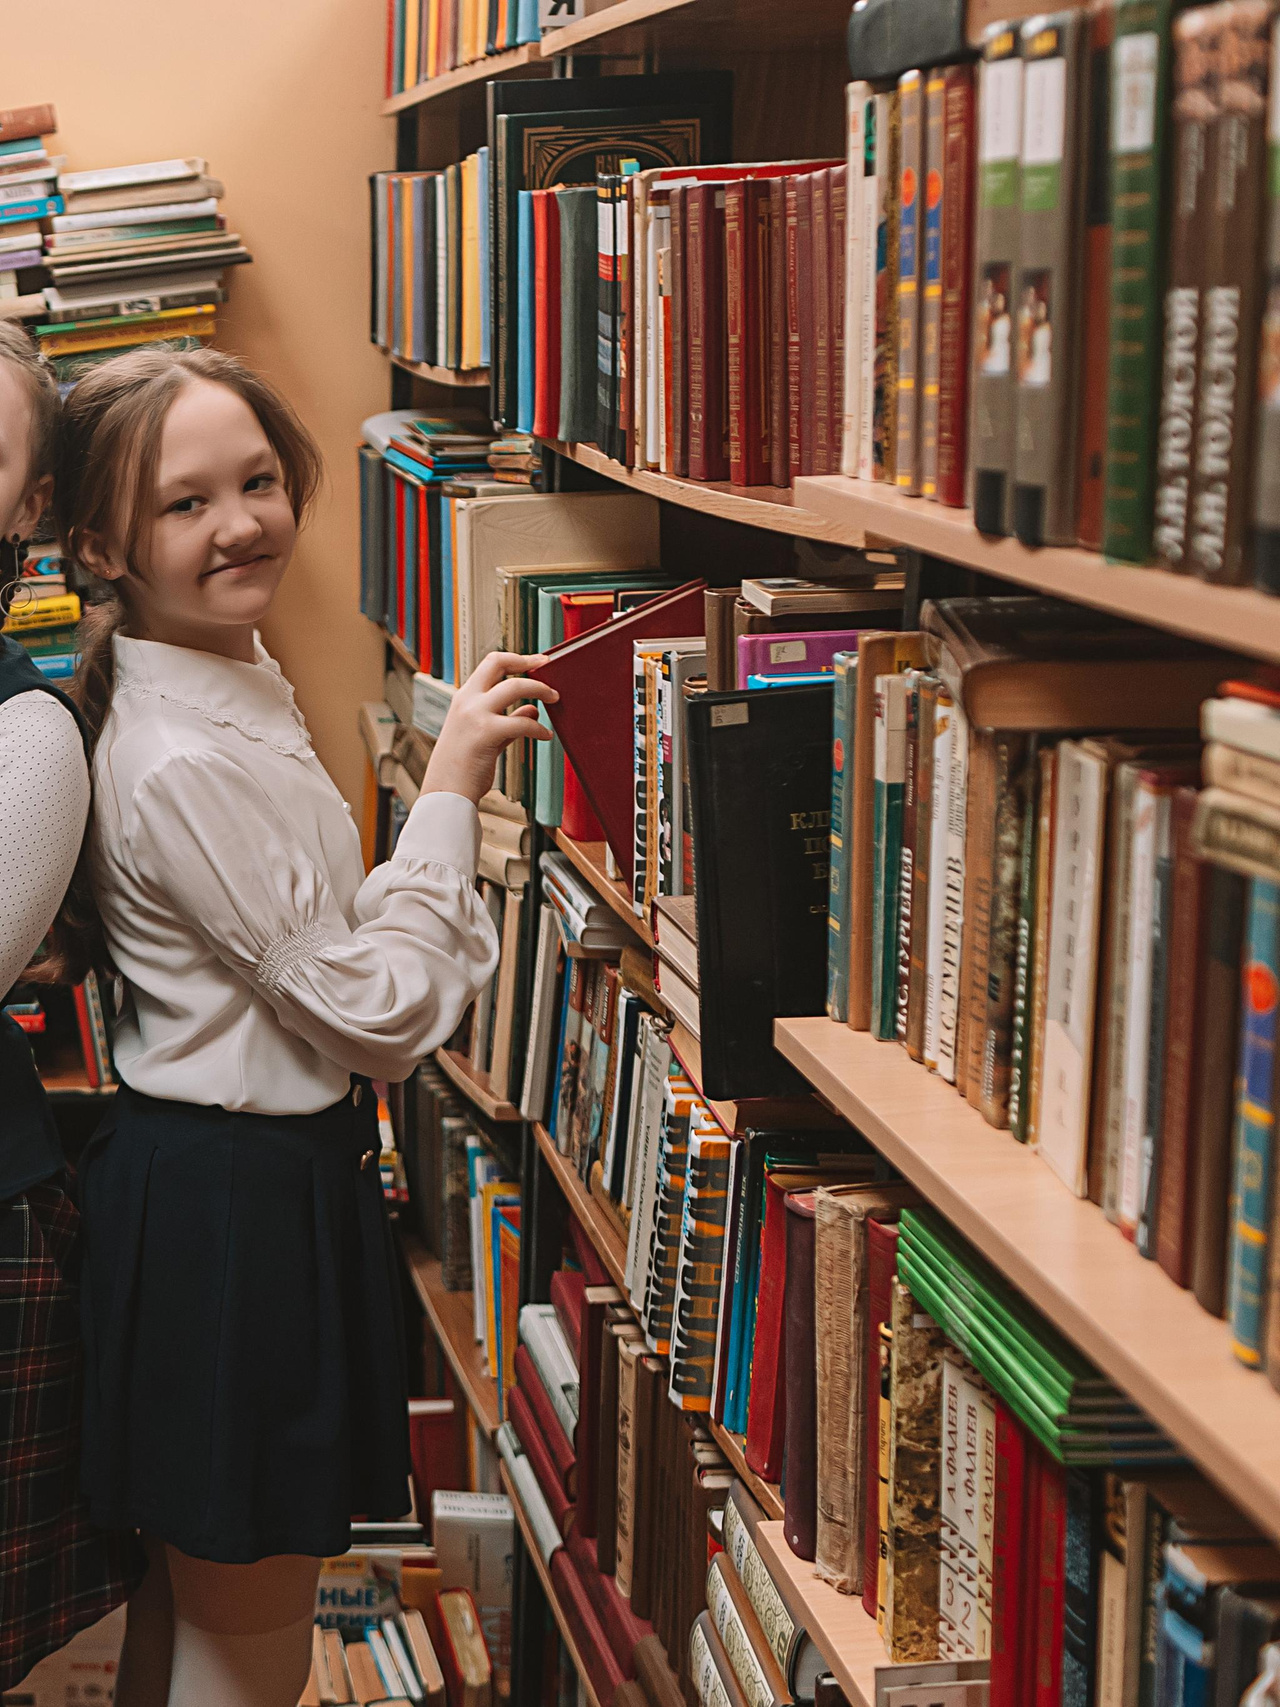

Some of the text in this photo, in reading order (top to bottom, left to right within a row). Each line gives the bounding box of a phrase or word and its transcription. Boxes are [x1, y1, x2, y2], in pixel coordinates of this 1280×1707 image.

[1161, 287, 1199, 469] ТОЛСТОЙ
[1199, 285, 1240, 475] ТОЛСТОЙ
[898, 846, 914, 978] ТУРГЕНЕВ
[941, 856, 962, 1001] ТУРГЕНЕВ
[671, 1153, 730, 1397] РУССКАЯ
[946, 1384, 961, 1503] А. ФАДЕЕВ
[964, 1403, 979, 1525] А. ФАДЕЕВ
[982, 1428, 996, 1523] ФАДЕЕВ
[946, 1575, 957, 1607] 3
[960, 1601, 972, 1631] 2
